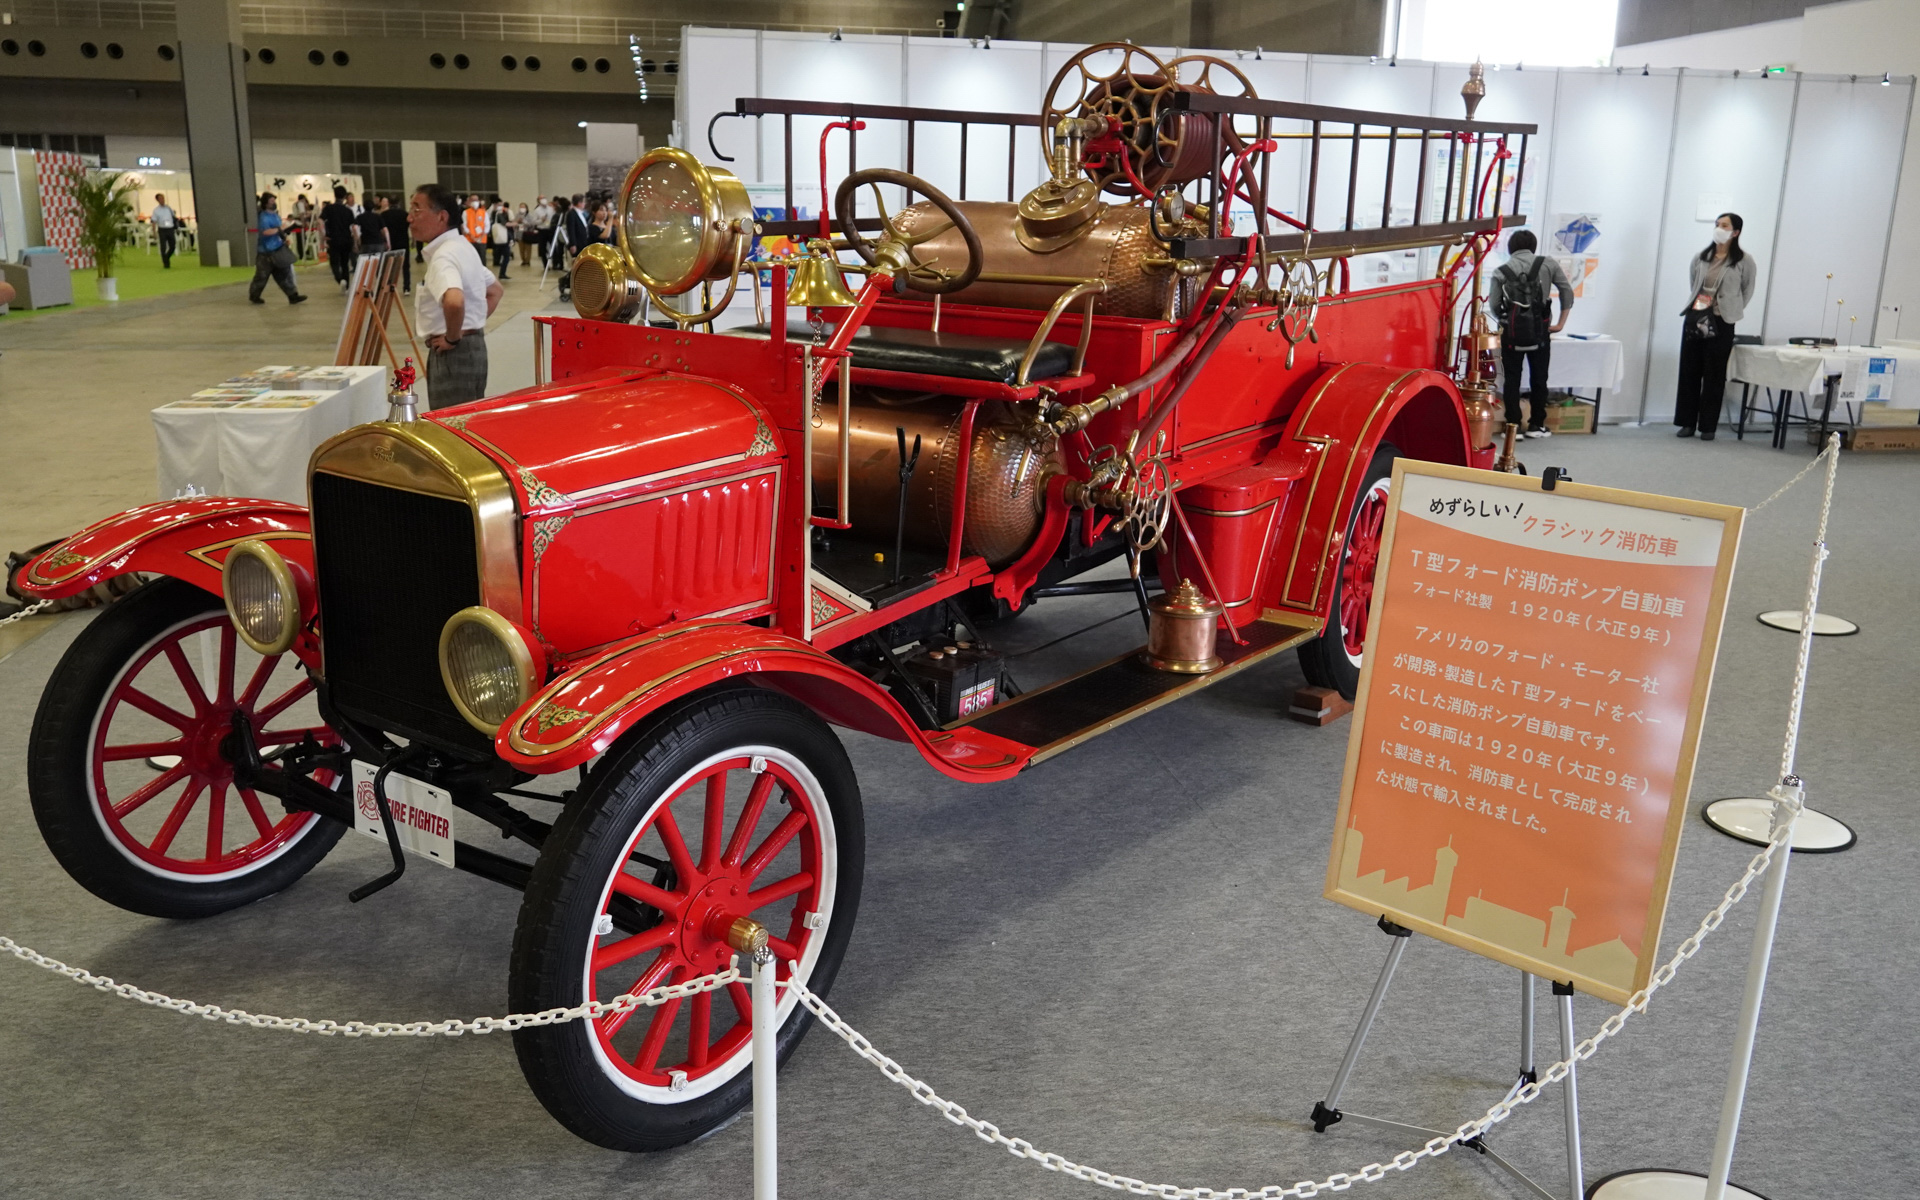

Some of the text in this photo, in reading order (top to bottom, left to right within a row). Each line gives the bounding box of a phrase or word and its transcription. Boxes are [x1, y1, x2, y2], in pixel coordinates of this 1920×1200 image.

[374, 446, 395, 462] Ford
[1523, 515, 1679, 557] クラシック消防車
[1410, 549, 1686, 618] T型フォード消防ポンプ自動車
[1412, 581, 1493, 610] フォード社製
[1414, 625, 1661, 695] アメリカのフォード・モーター社
[963, 691, 988, 716] 585
[1388, 683, 1616, 755] スにした消防ポンプ自動車です。
[408, 805, 449, 839] FIGHTER
[1375, 768, 1547, 834] た状態で輸入されました。
